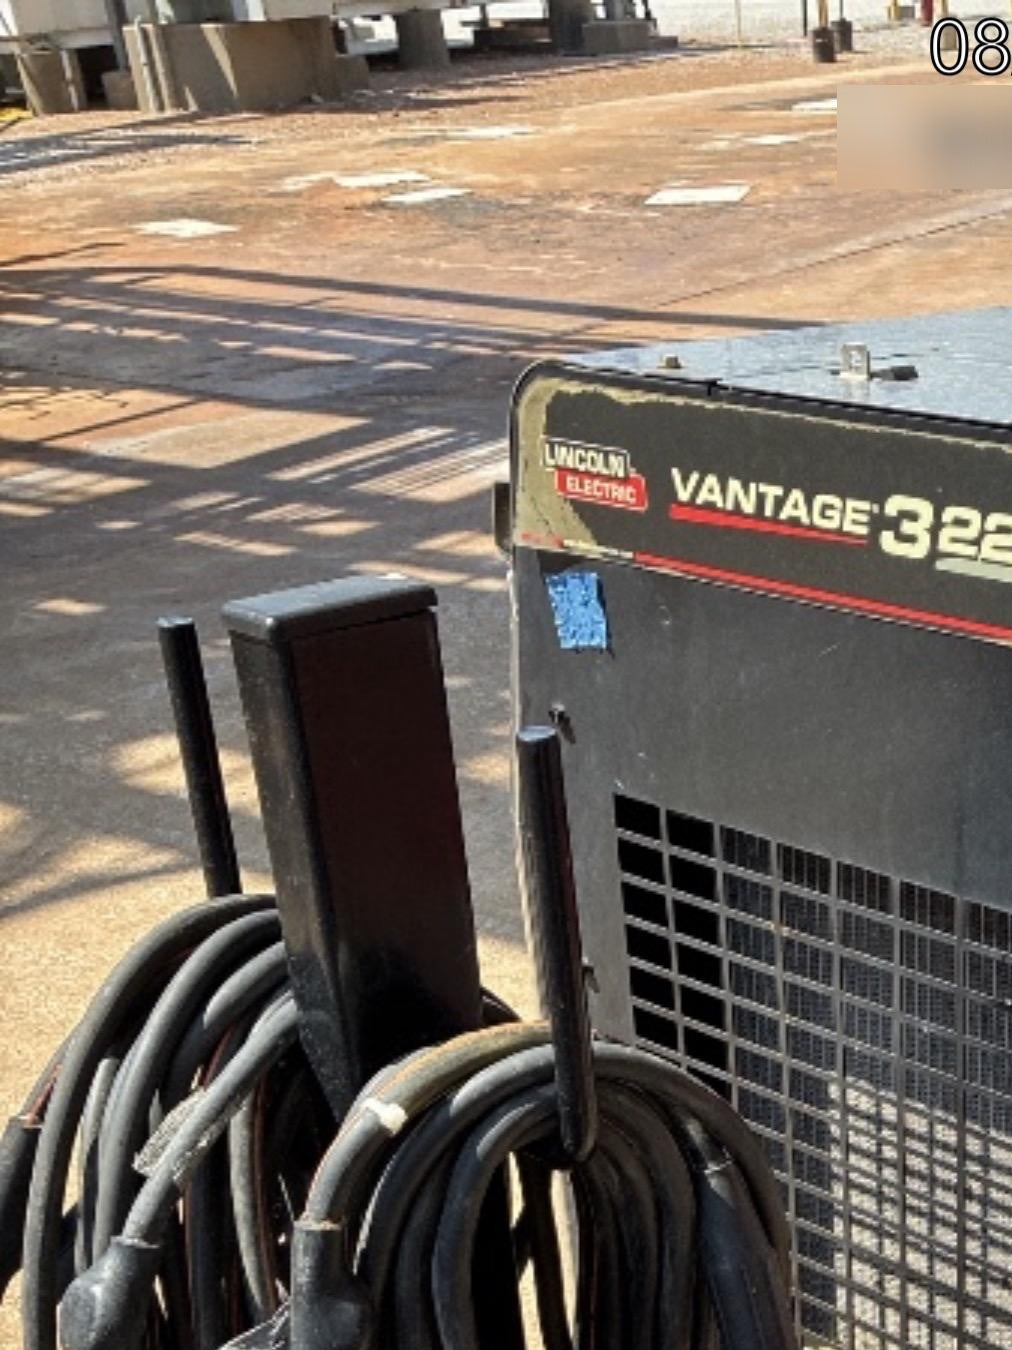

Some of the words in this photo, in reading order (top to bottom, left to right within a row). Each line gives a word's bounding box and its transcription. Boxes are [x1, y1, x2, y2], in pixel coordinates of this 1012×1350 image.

[544, 442, 625, 478] LINCOLN
[565, 474, 637, 504] ELECTRIC
[670, 467, 871, 535] VANTAGE
